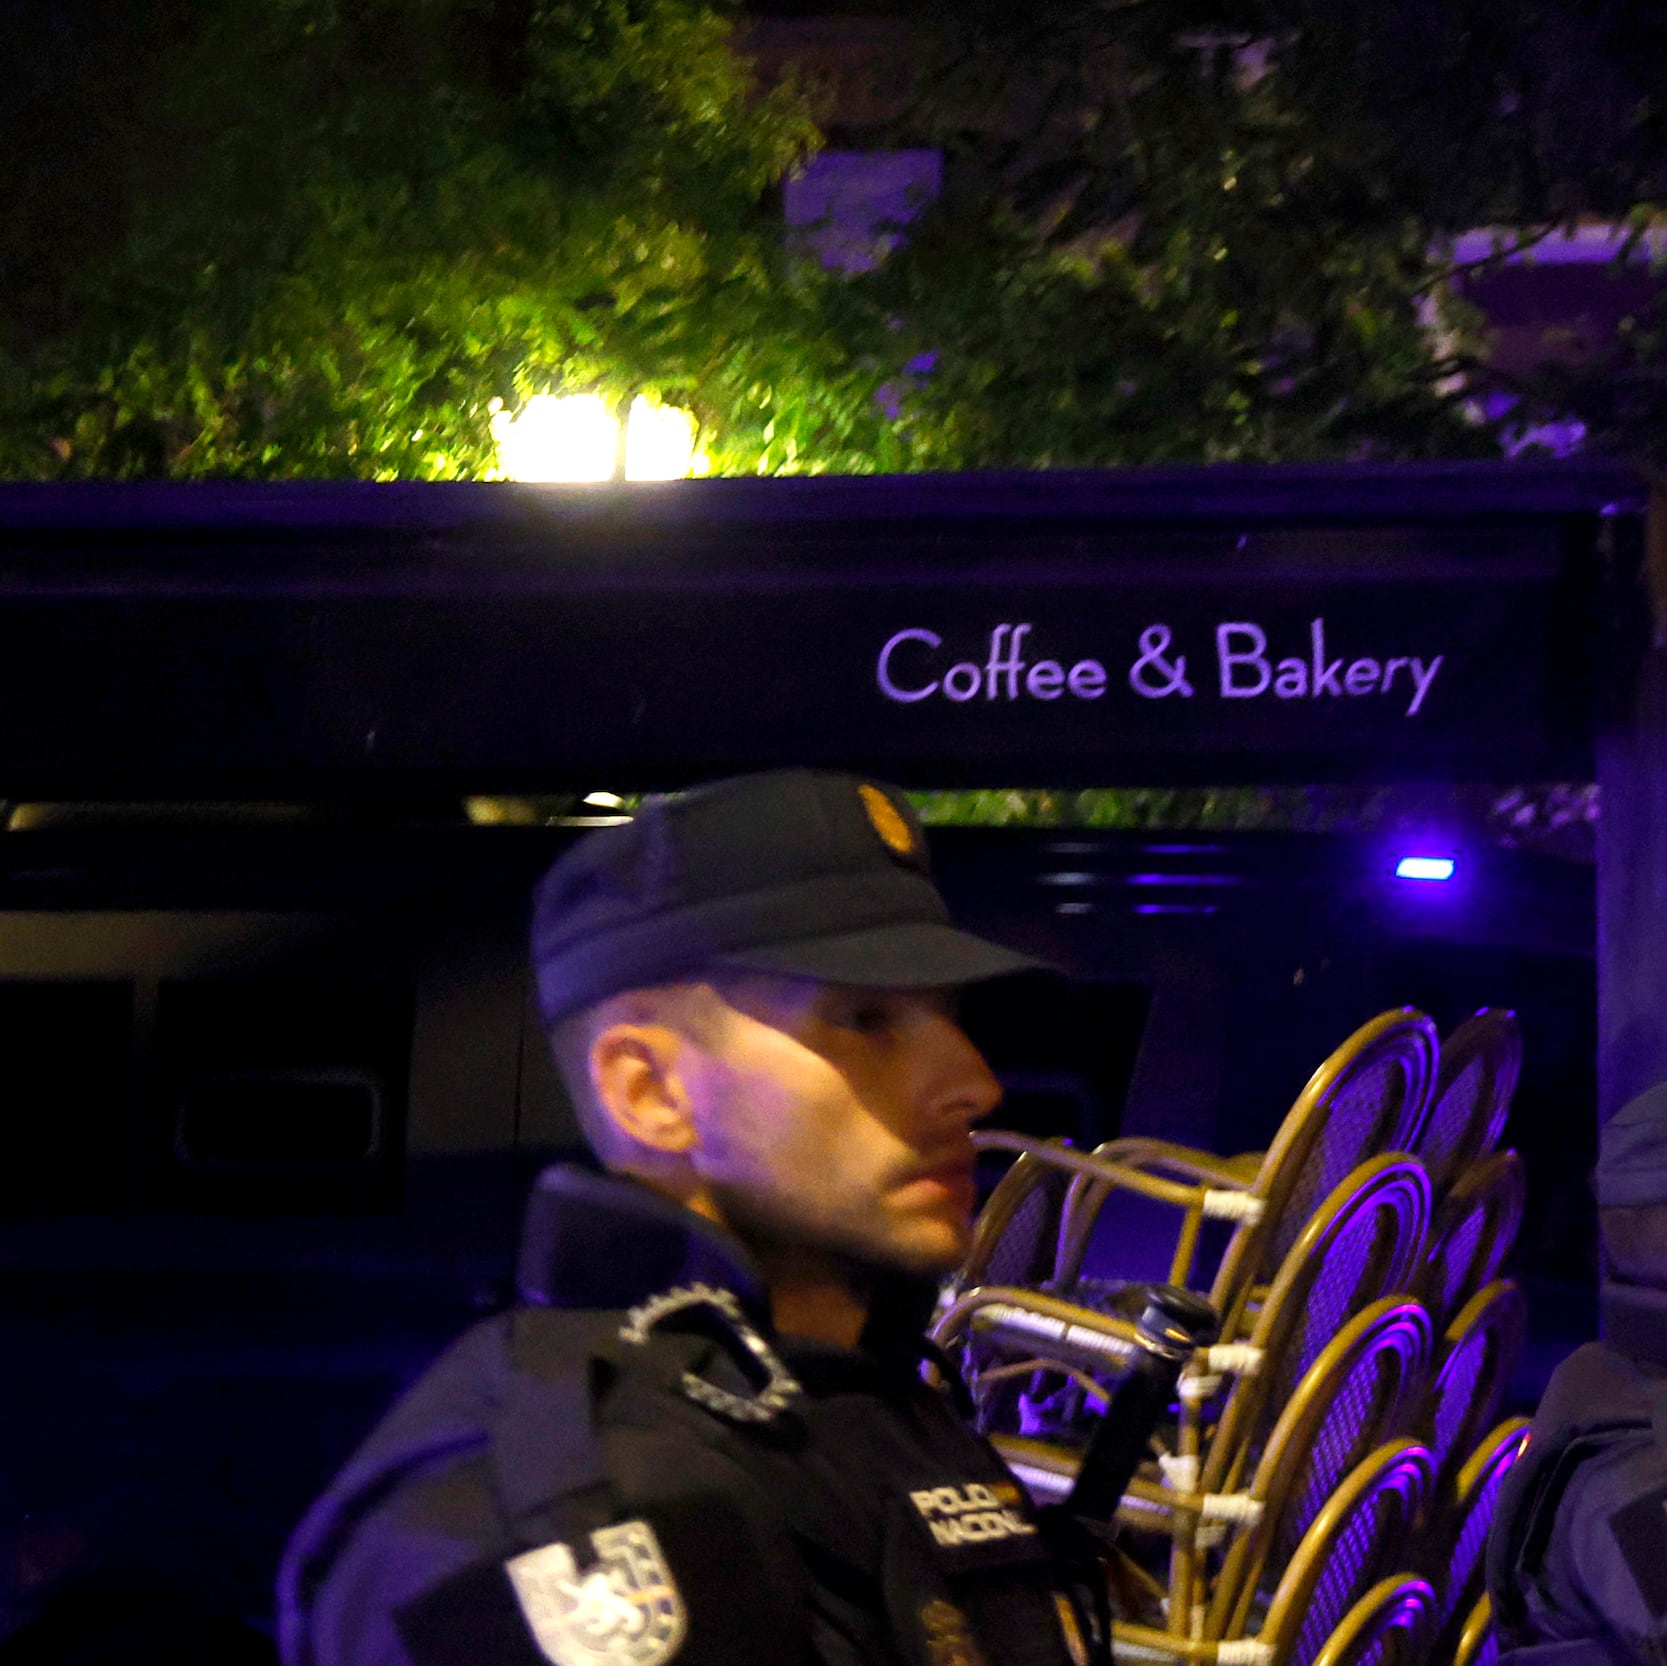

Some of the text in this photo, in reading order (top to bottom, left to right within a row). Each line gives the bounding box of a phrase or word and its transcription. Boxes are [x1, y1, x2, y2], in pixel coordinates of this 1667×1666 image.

[875, 617, 1444, 716] Coffee & Bakery
